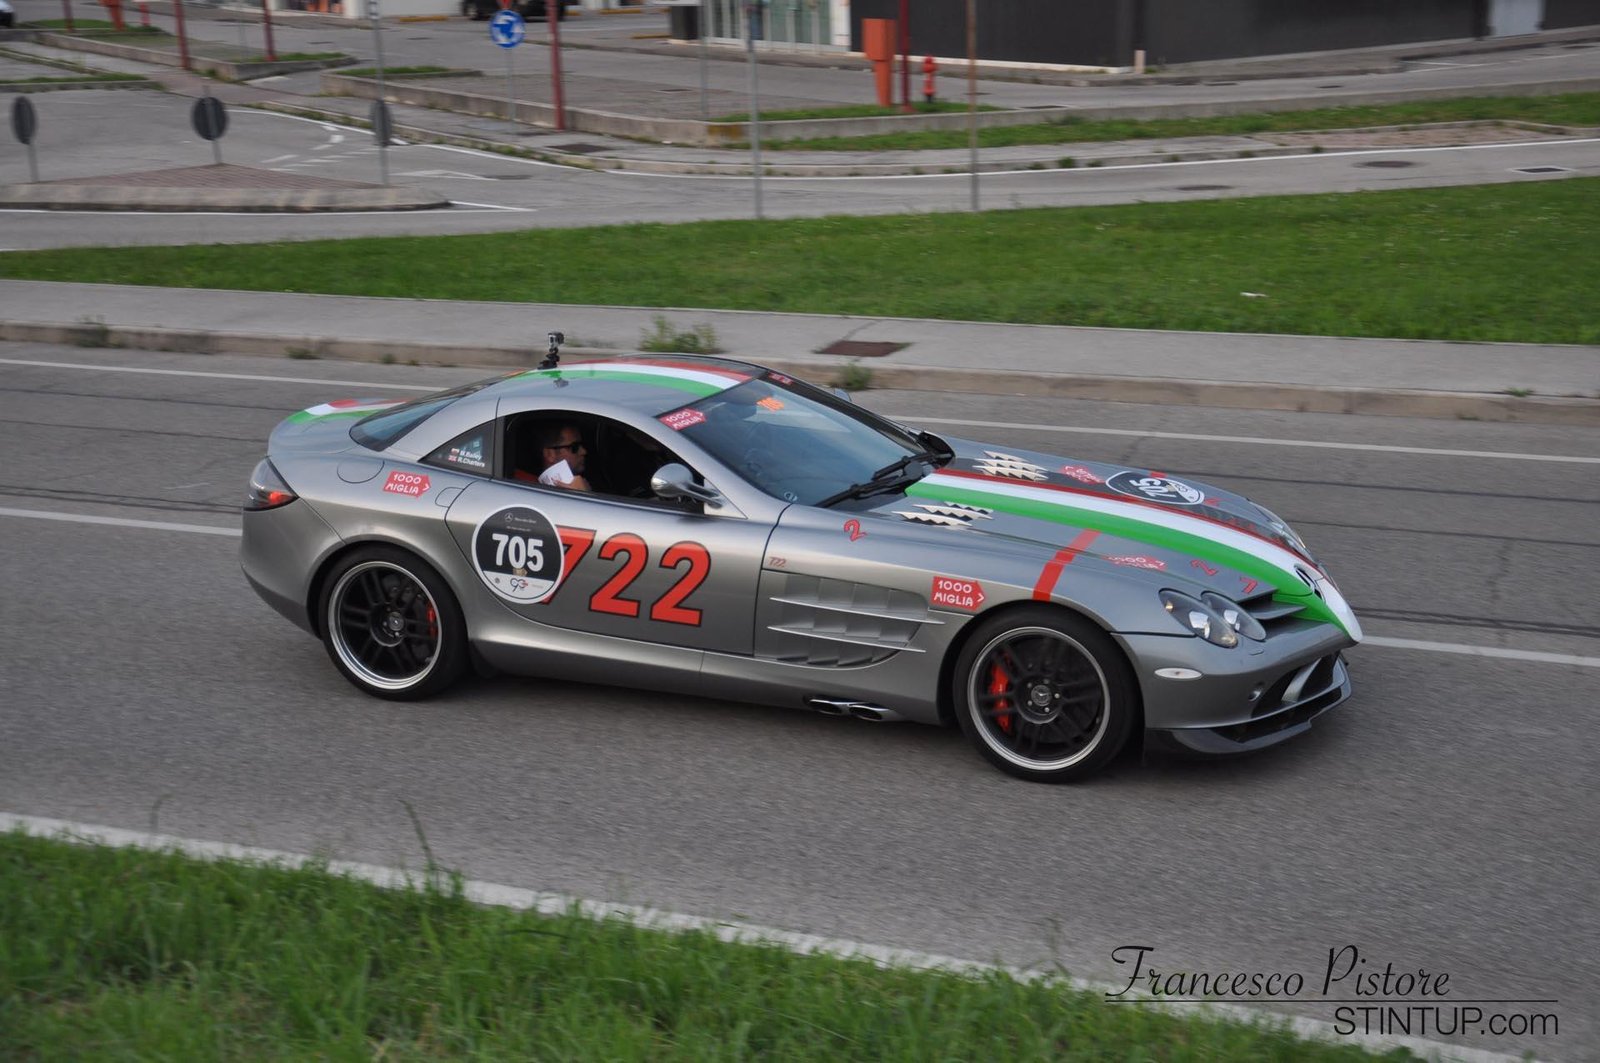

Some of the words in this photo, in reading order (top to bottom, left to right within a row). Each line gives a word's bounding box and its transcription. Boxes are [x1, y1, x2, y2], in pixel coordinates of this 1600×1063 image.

[665, 411, 690, 422] 1000
[393, 473, 422, 484] 1000
[385, 483, 419, 494] MIGLIA
[843, 518, 868, 541] 2
[491, 532, 544, 572] 705
[541, 524, 711, 627] 722
[938, 580, 972, 593] 1000
[933, 591, 974, 607] MIGLIA
